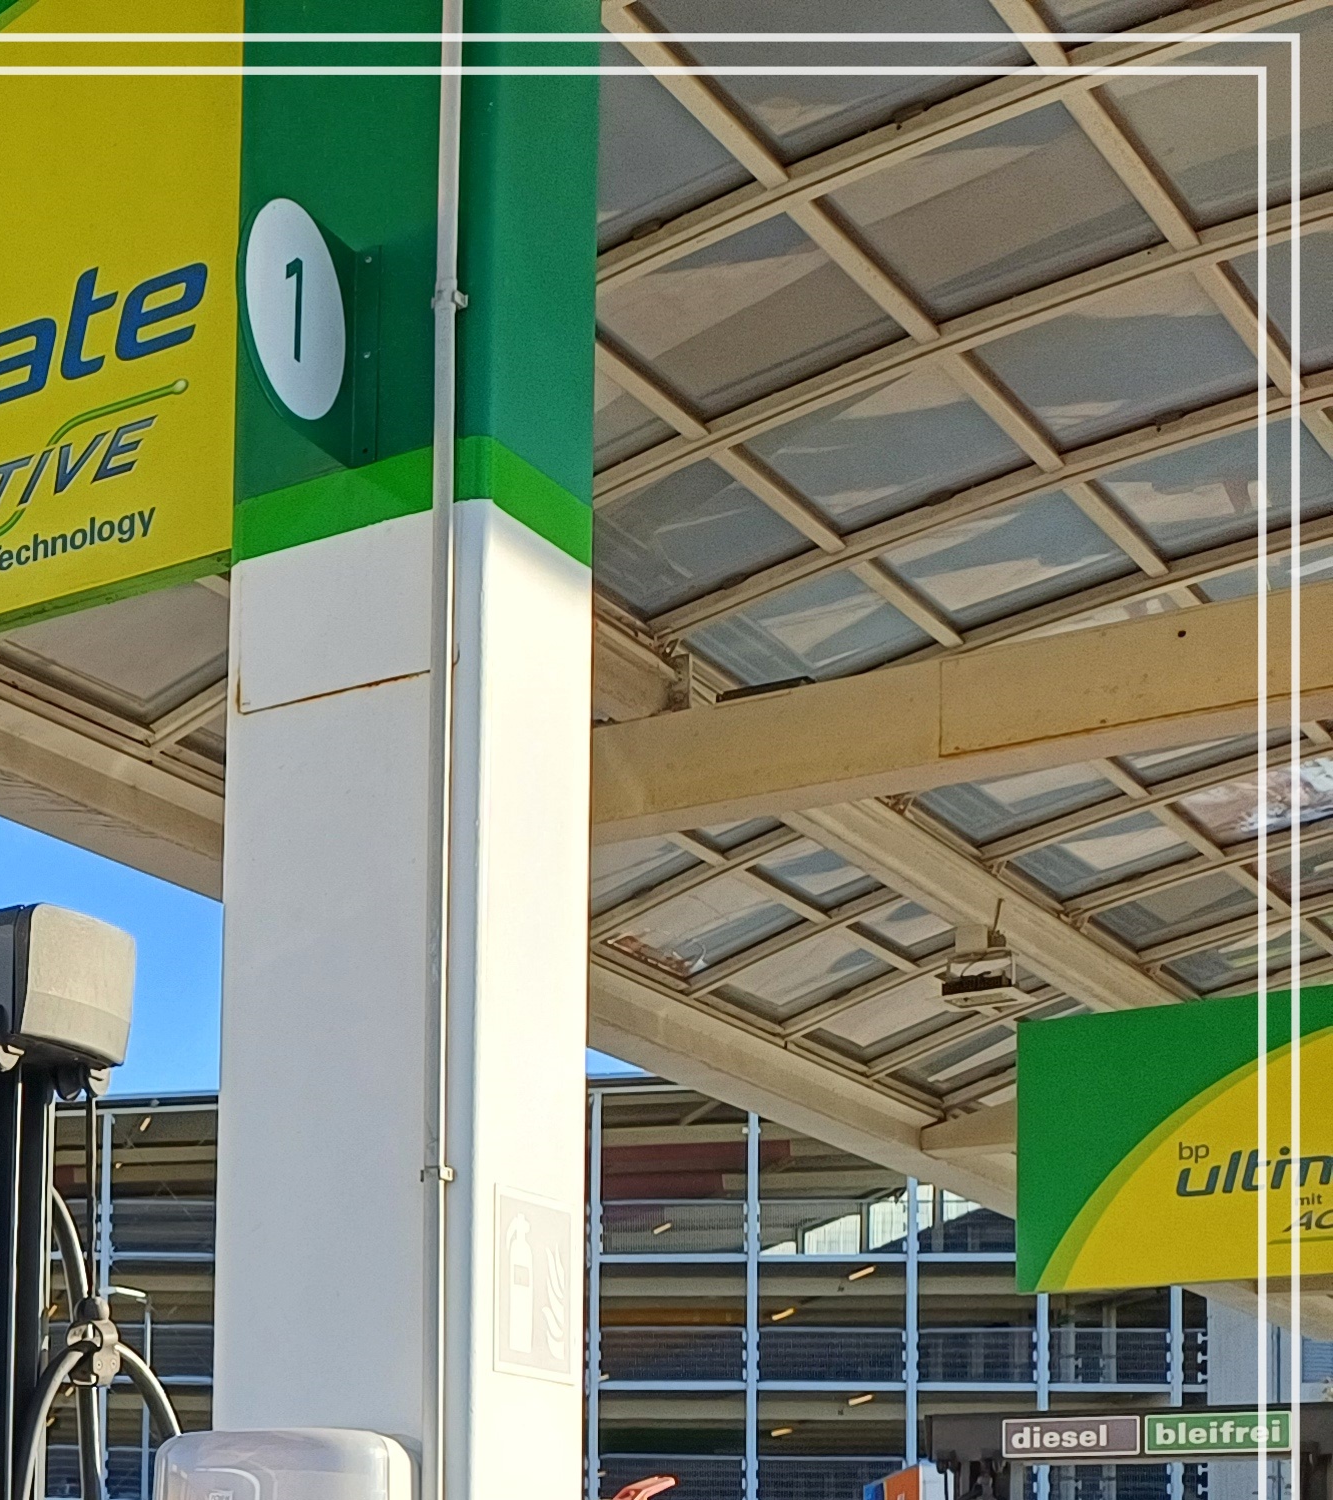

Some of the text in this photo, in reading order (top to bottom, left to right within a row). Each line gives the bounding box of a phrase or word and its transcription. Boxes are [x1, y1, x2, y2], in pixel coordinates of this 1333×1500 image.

[283, 257, 304, 363] 1
[1177, 1142, 1210, 1164] bp
[1297, 1193, 1323, 1206] mit
[1011, 1424, 1107, 1449] diesel
[1155, 1420, 1281, 1446] bleifrei
